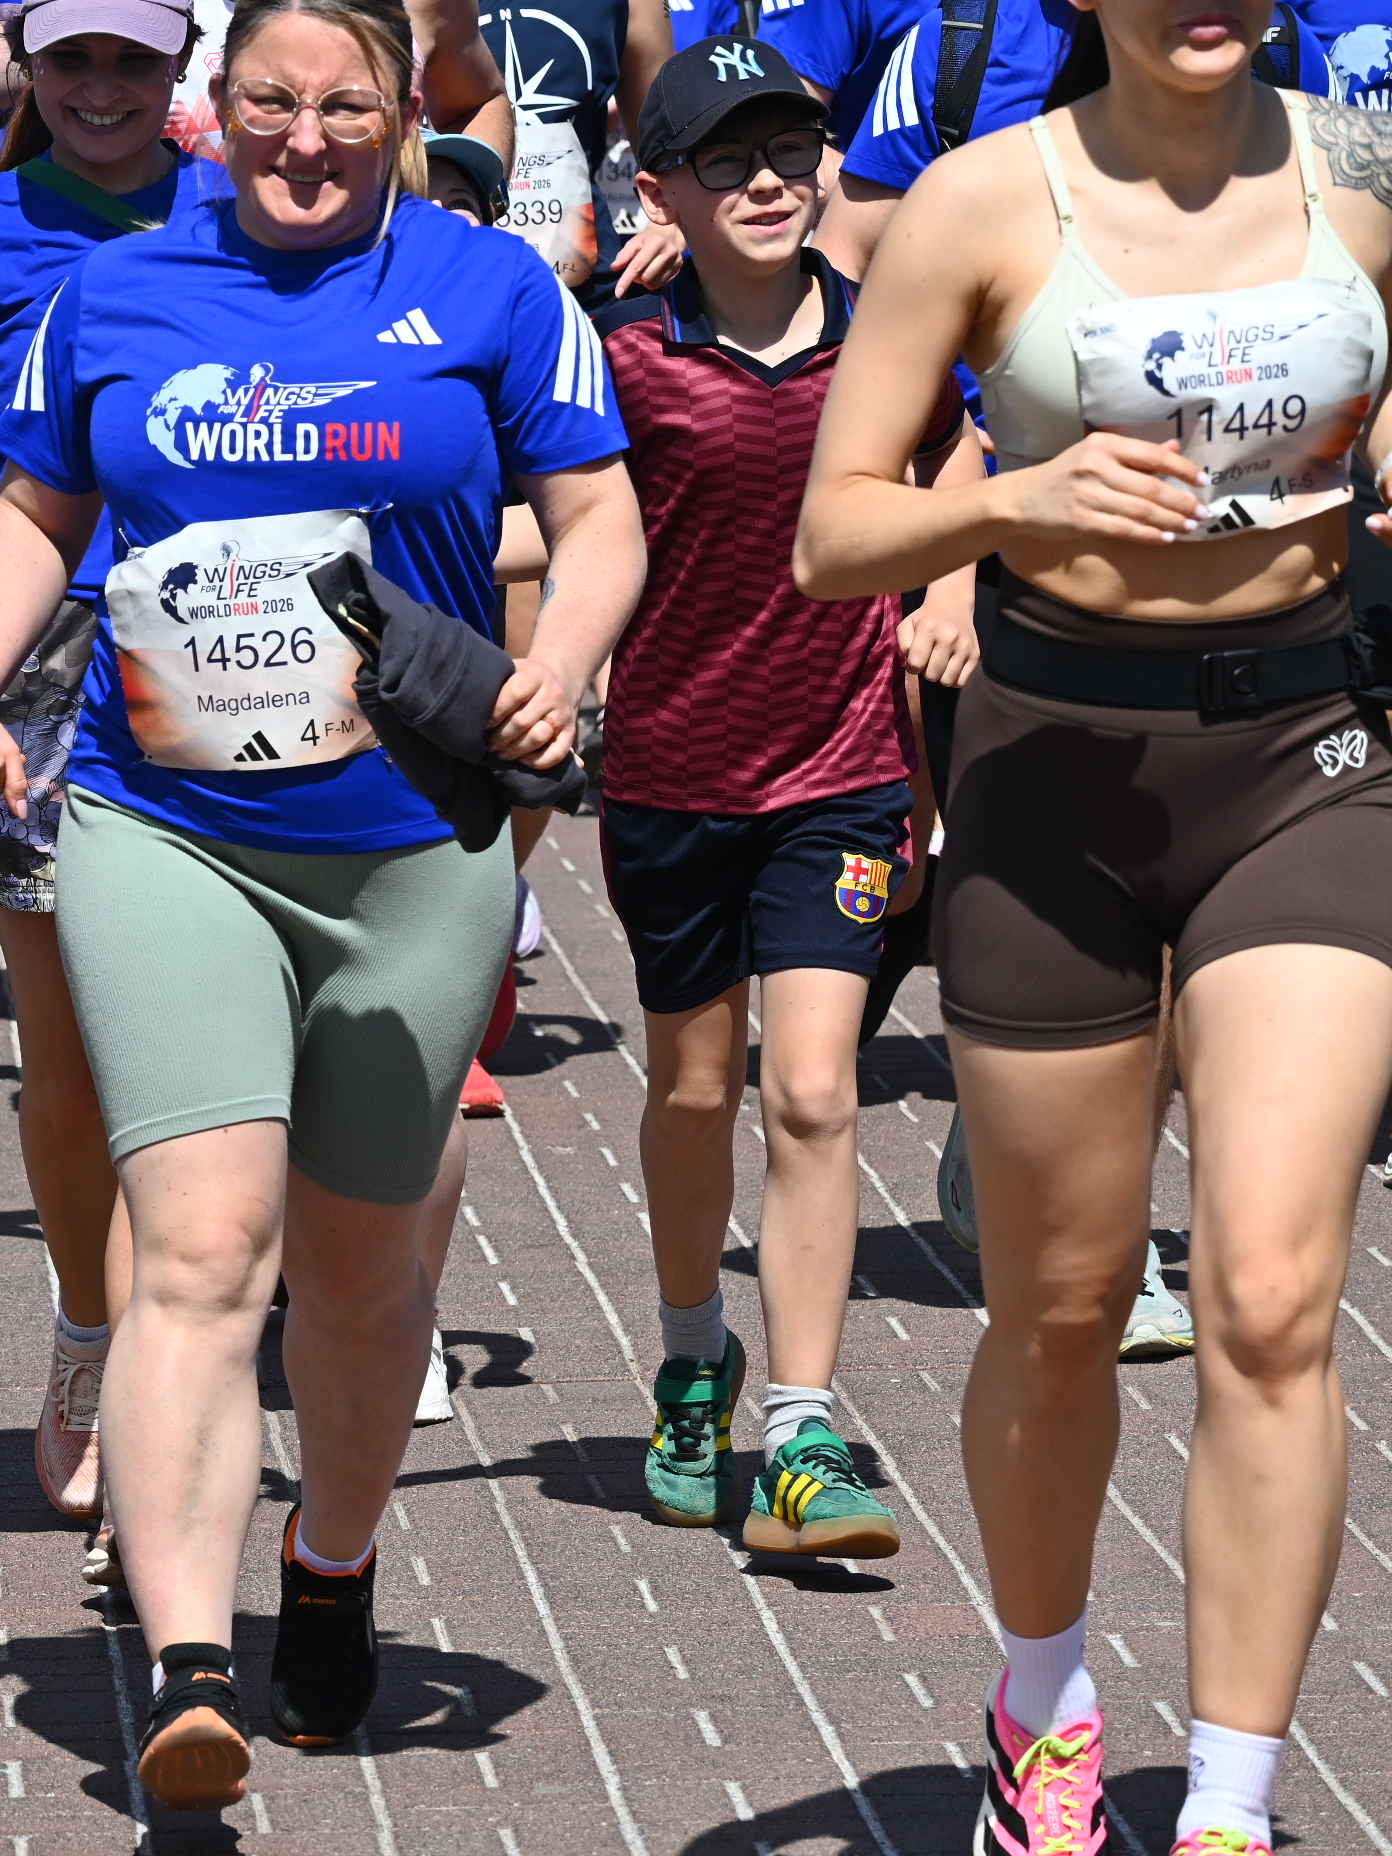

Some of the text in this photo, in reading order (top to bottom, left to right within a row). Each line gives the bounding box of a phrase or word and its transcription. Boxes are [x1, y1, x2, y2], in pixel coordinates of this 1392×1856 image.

[709, 43, 765, 81] NY
[533, 179, 551, 190] 2026
[1190, 323, 1275, 350] WINGS
[1207, 345, 1255, 368] LIFE
[1176, 363, 1289, 392] WORLD RUN 2026
[225, 386, 317, 406] WINGS
[218, 405, 290, 423] FOR LIFE
[1166, 394, 1307, 442] 11449
[185, 421, 401, 462] WORLD RUN
[1204, 458, 1272, 486] artyna
[1269, 475, 1286, 504] 4
[204, 560, 283, 583] WINGS
[200, 581, 262, 600] FOR LIFE
[188, 598, 294, 620] WORLD RUN 2026
[184, 626, 316, 673] 14526
[197, 690, 311, 716] Magdalena
[300, 718, 356, 747] 4 F-M
[854, 881, 876, 894] FCB
